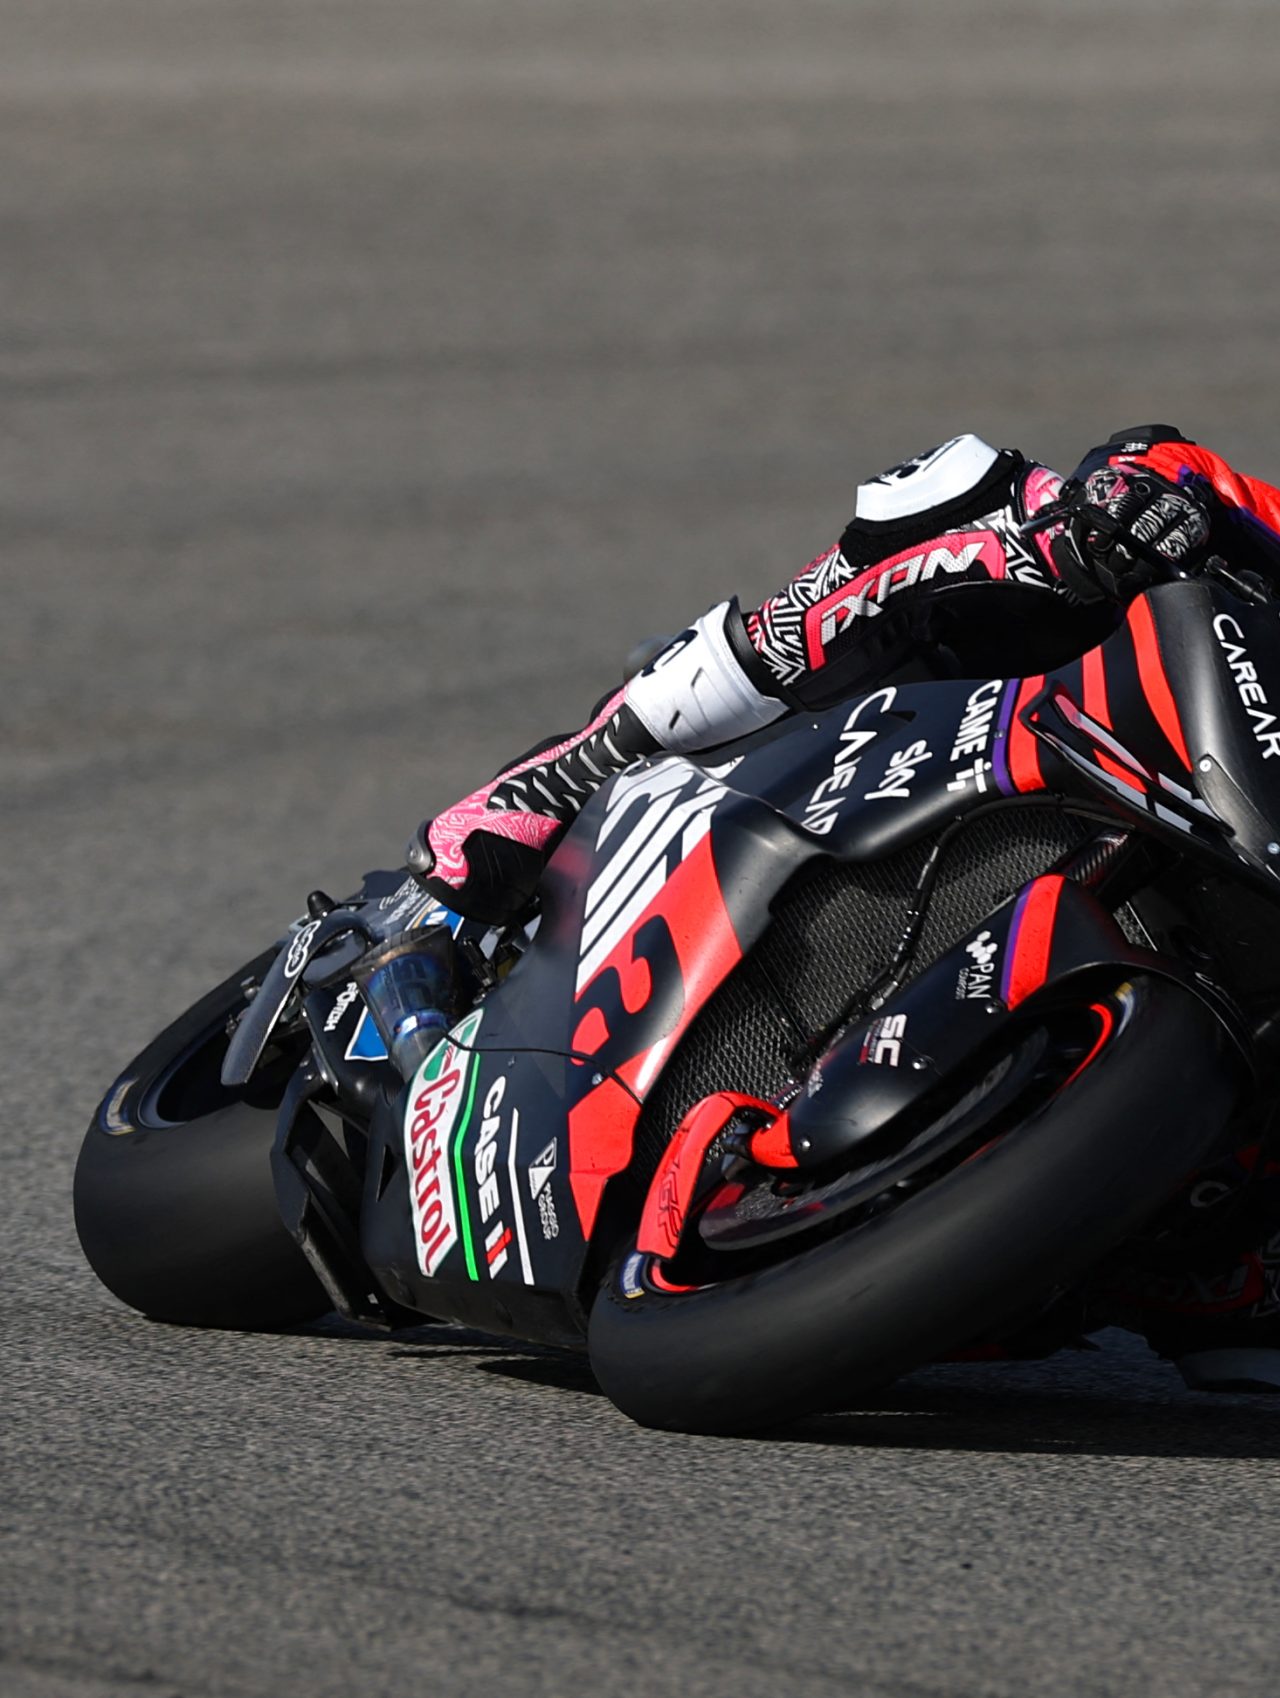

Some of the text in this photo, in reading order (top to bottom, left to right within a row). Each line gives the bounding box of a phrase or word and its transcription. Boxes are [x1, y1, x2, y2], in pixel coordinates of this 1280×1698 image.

[966, 962, 991, 999] PAN
[874, 1014, 907, 1067] SC
[411, 1068, 461, 1273] Castrol
[474, 1076, 506, 1224] CASE
